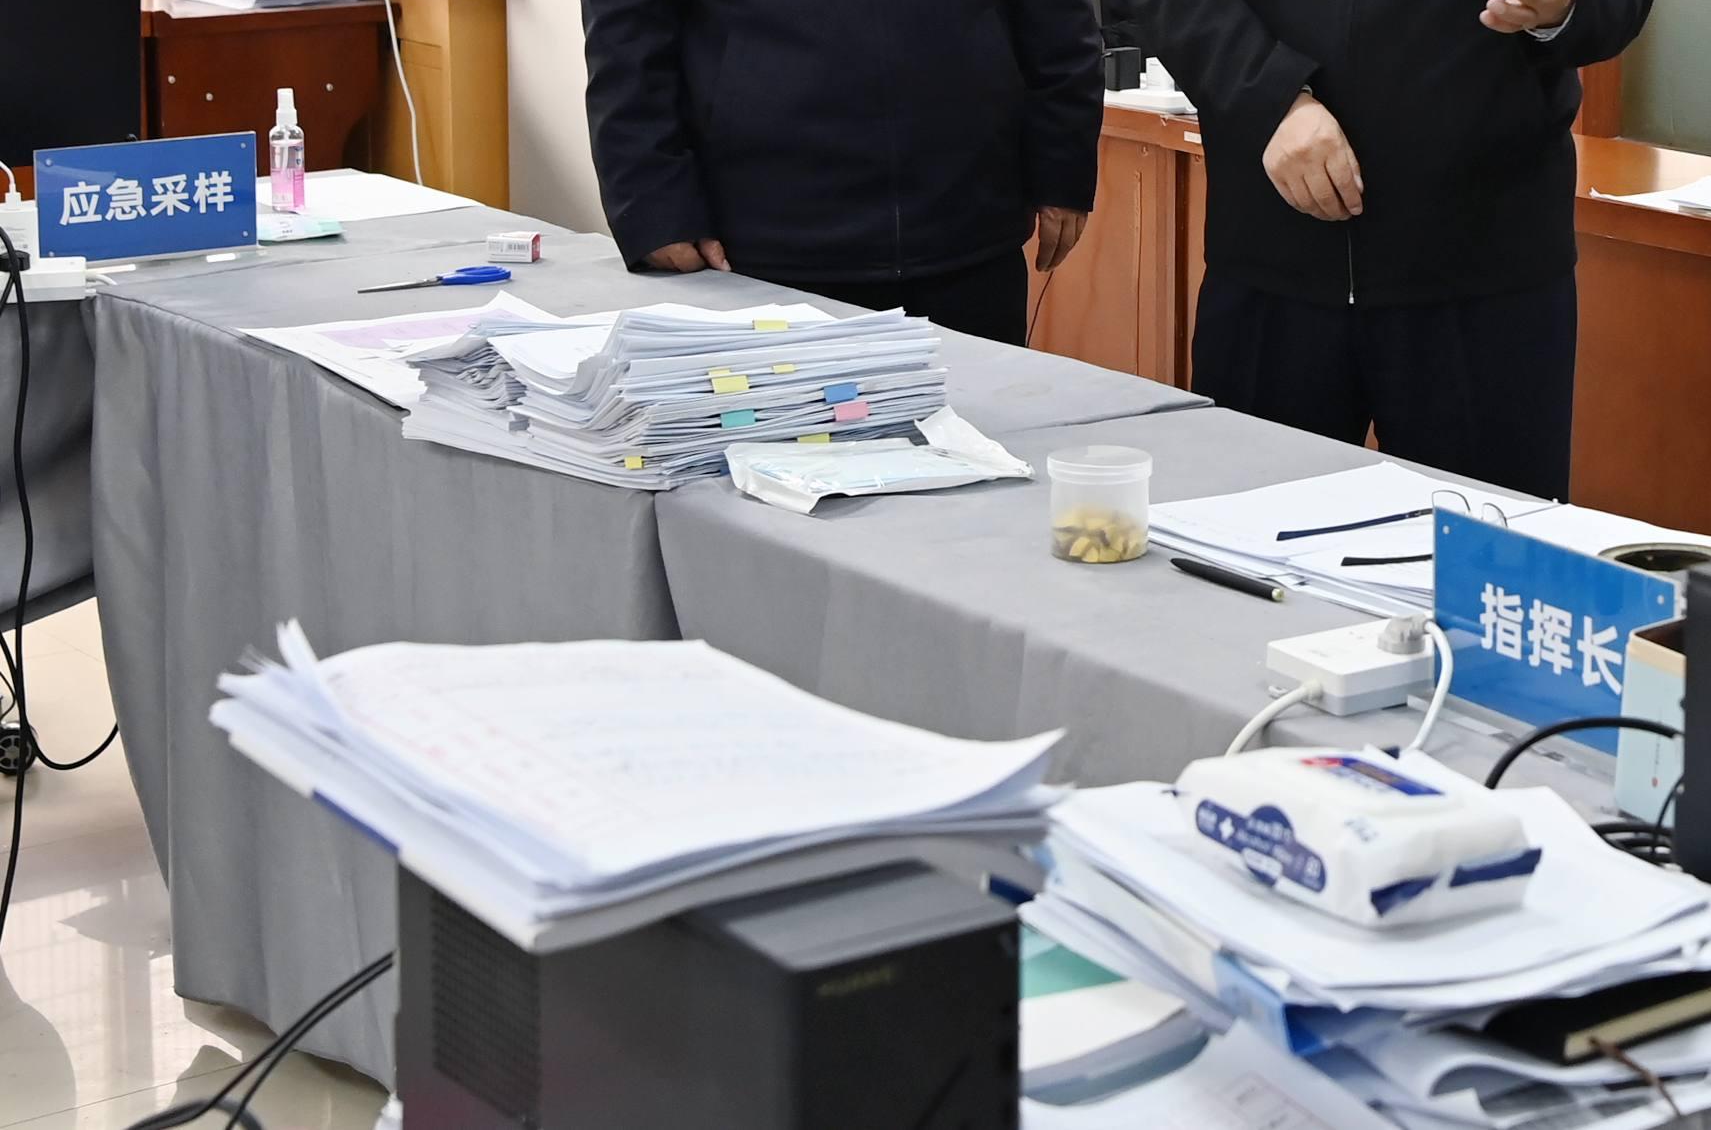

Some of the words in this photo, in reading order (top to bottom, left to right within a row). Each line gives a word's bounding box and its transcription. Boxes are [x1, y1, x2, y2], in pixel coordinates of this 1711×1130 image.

[59, 170, 235, 226] 应急采样
[1480, 582, 1623, 696] 指挥长
